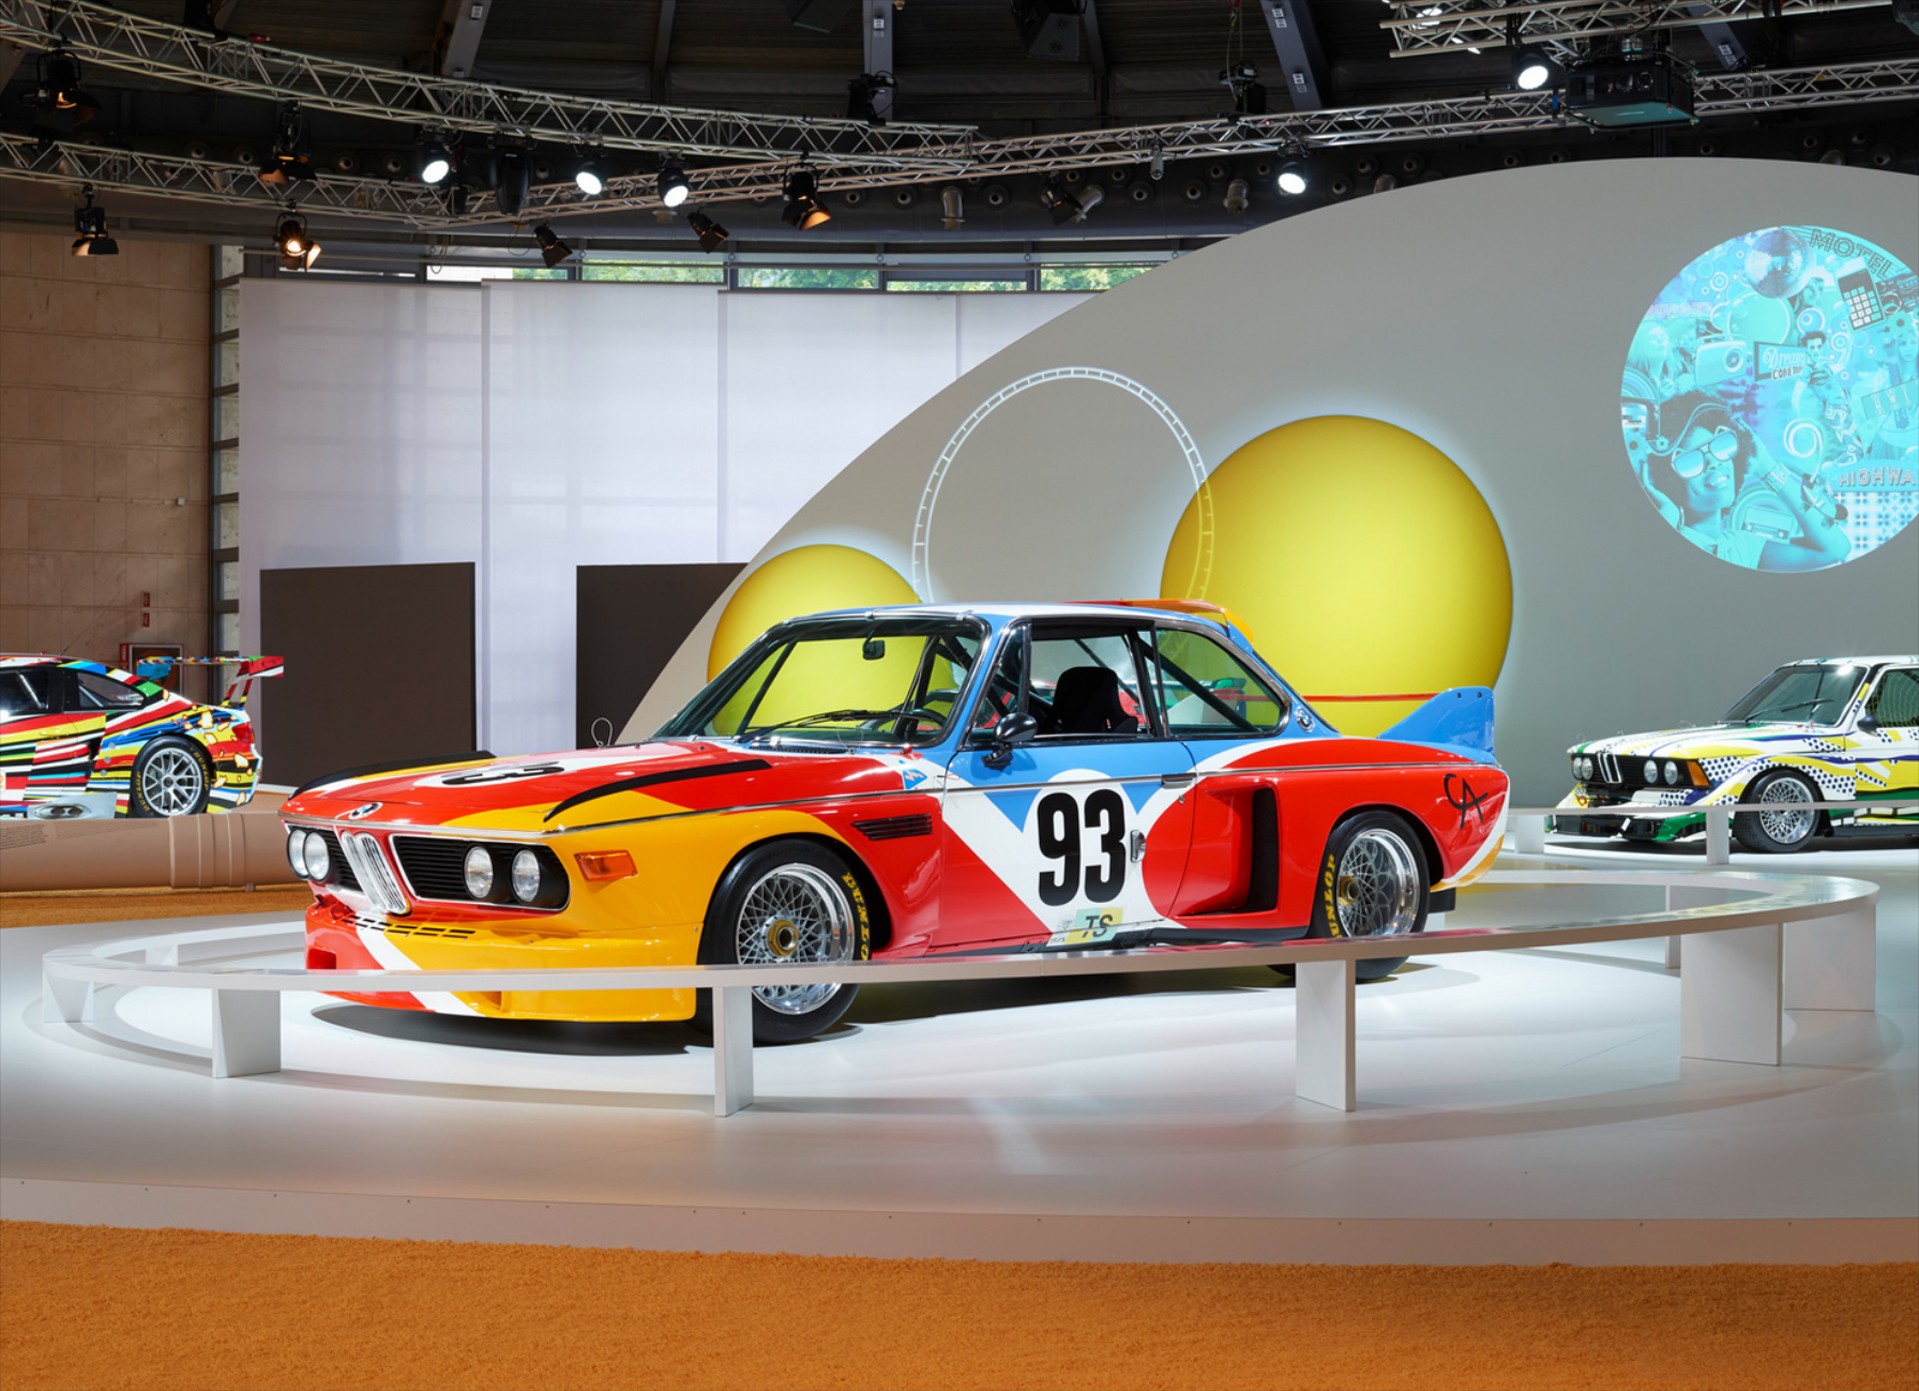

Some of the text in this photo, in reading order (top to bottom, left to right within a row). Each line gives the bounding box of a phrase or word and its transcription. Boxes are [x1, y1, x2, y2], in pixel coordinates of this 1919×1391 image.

[1809, 228, 1893, 281] MOTEL
[1037, 788, 1126, 907] 93
[841, 871, 870, 961] DUNLO
[1081, 914, 1114, 938] TS
